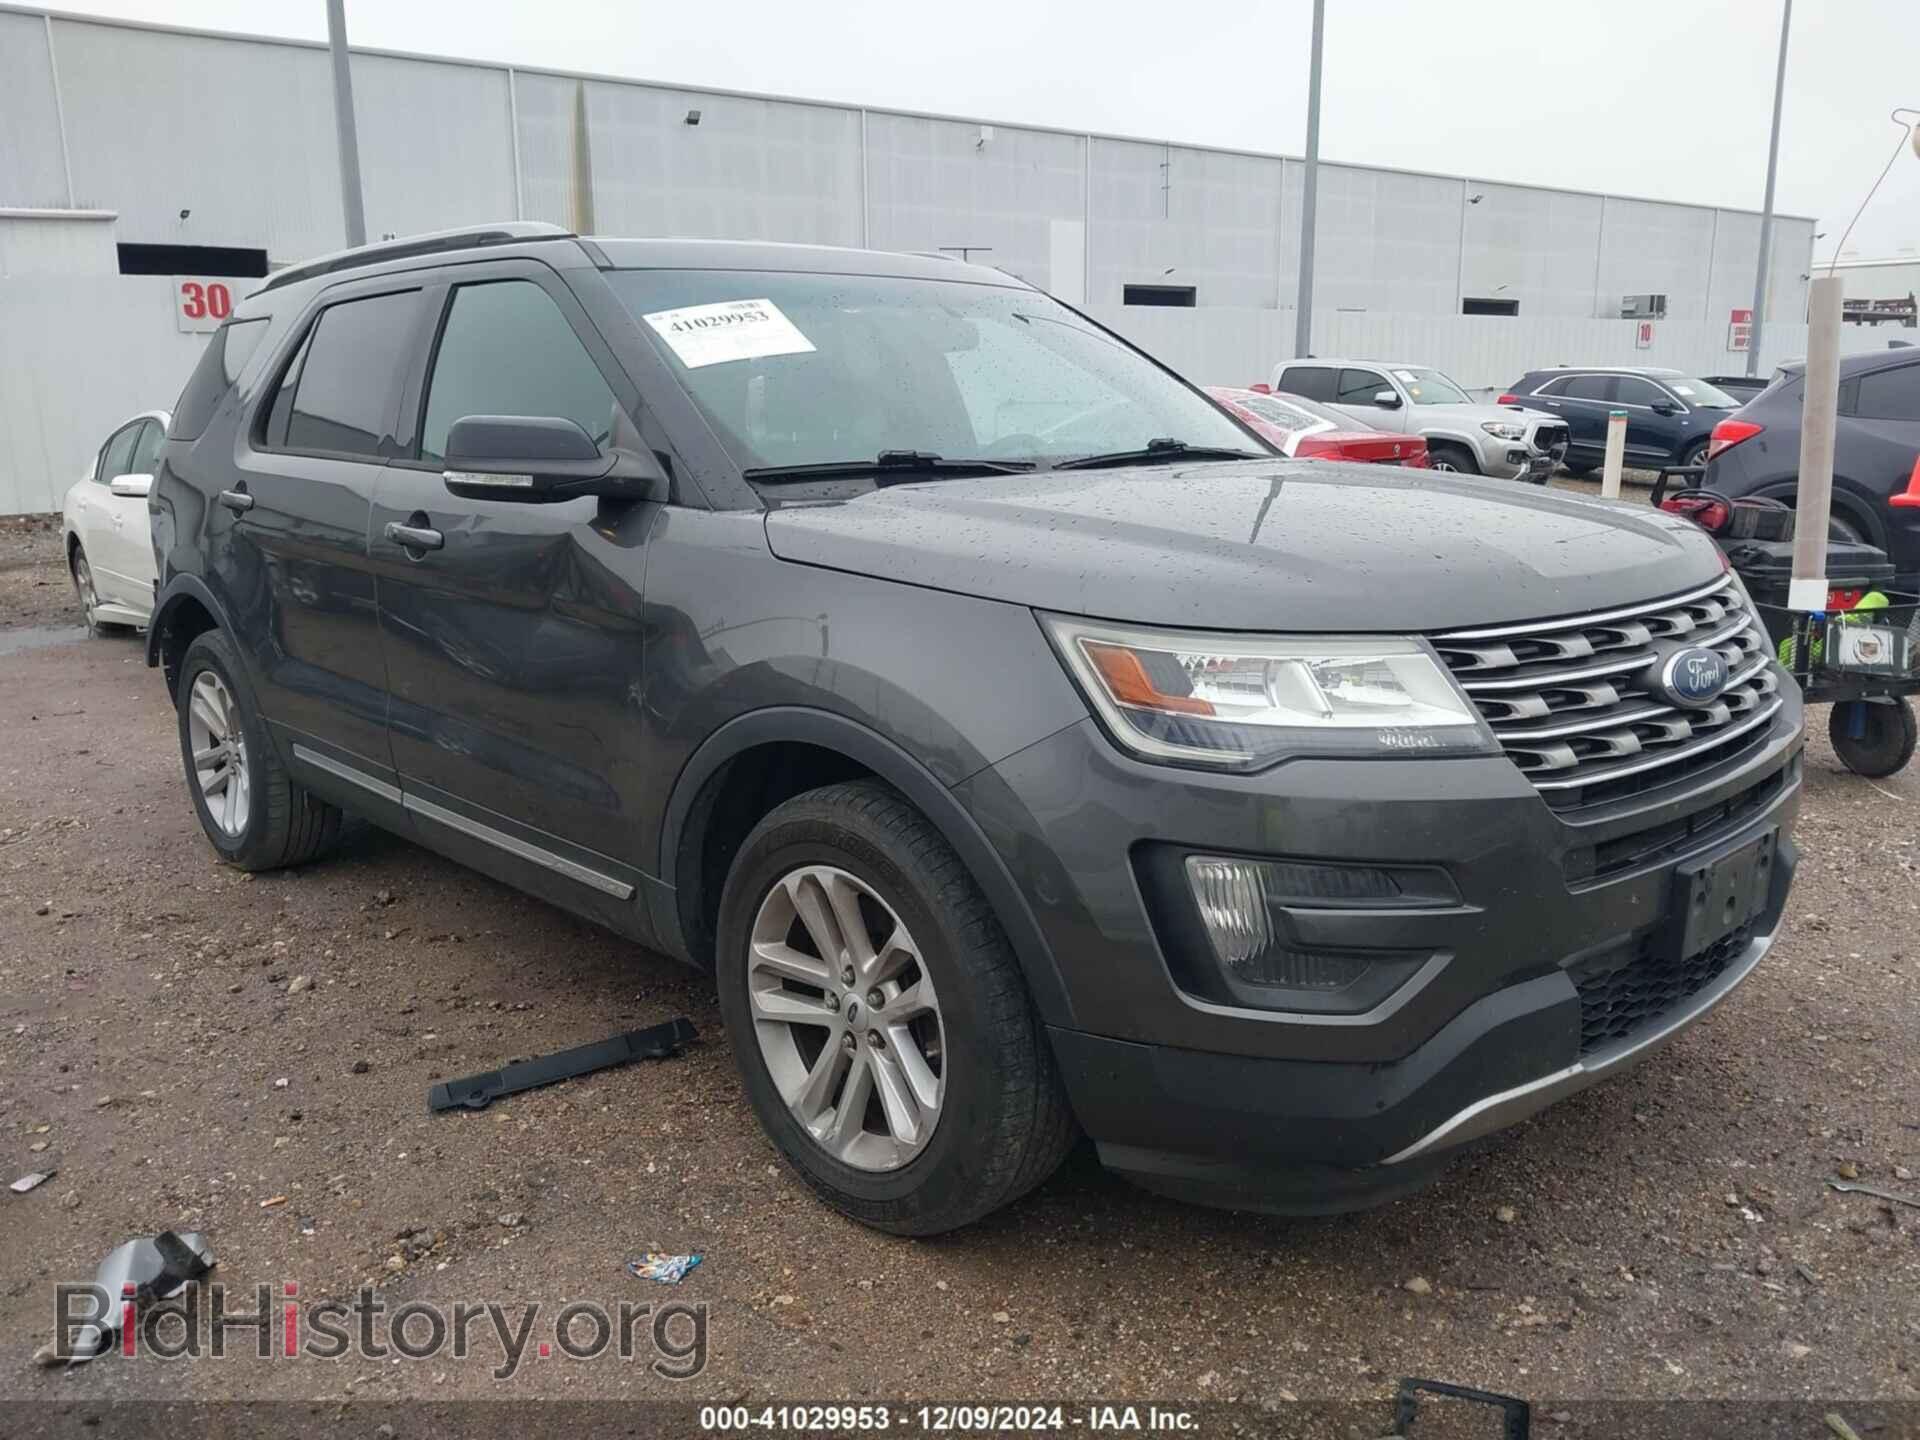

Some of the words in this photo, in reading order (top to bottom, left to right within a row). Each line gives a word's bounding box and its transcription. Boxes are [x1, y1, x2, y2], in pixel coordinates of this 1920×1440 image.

[182, 282, 230, 319] 30
[671, 311, 769, 332] 41029953
[1687, 656, 1719, 692] Ford
